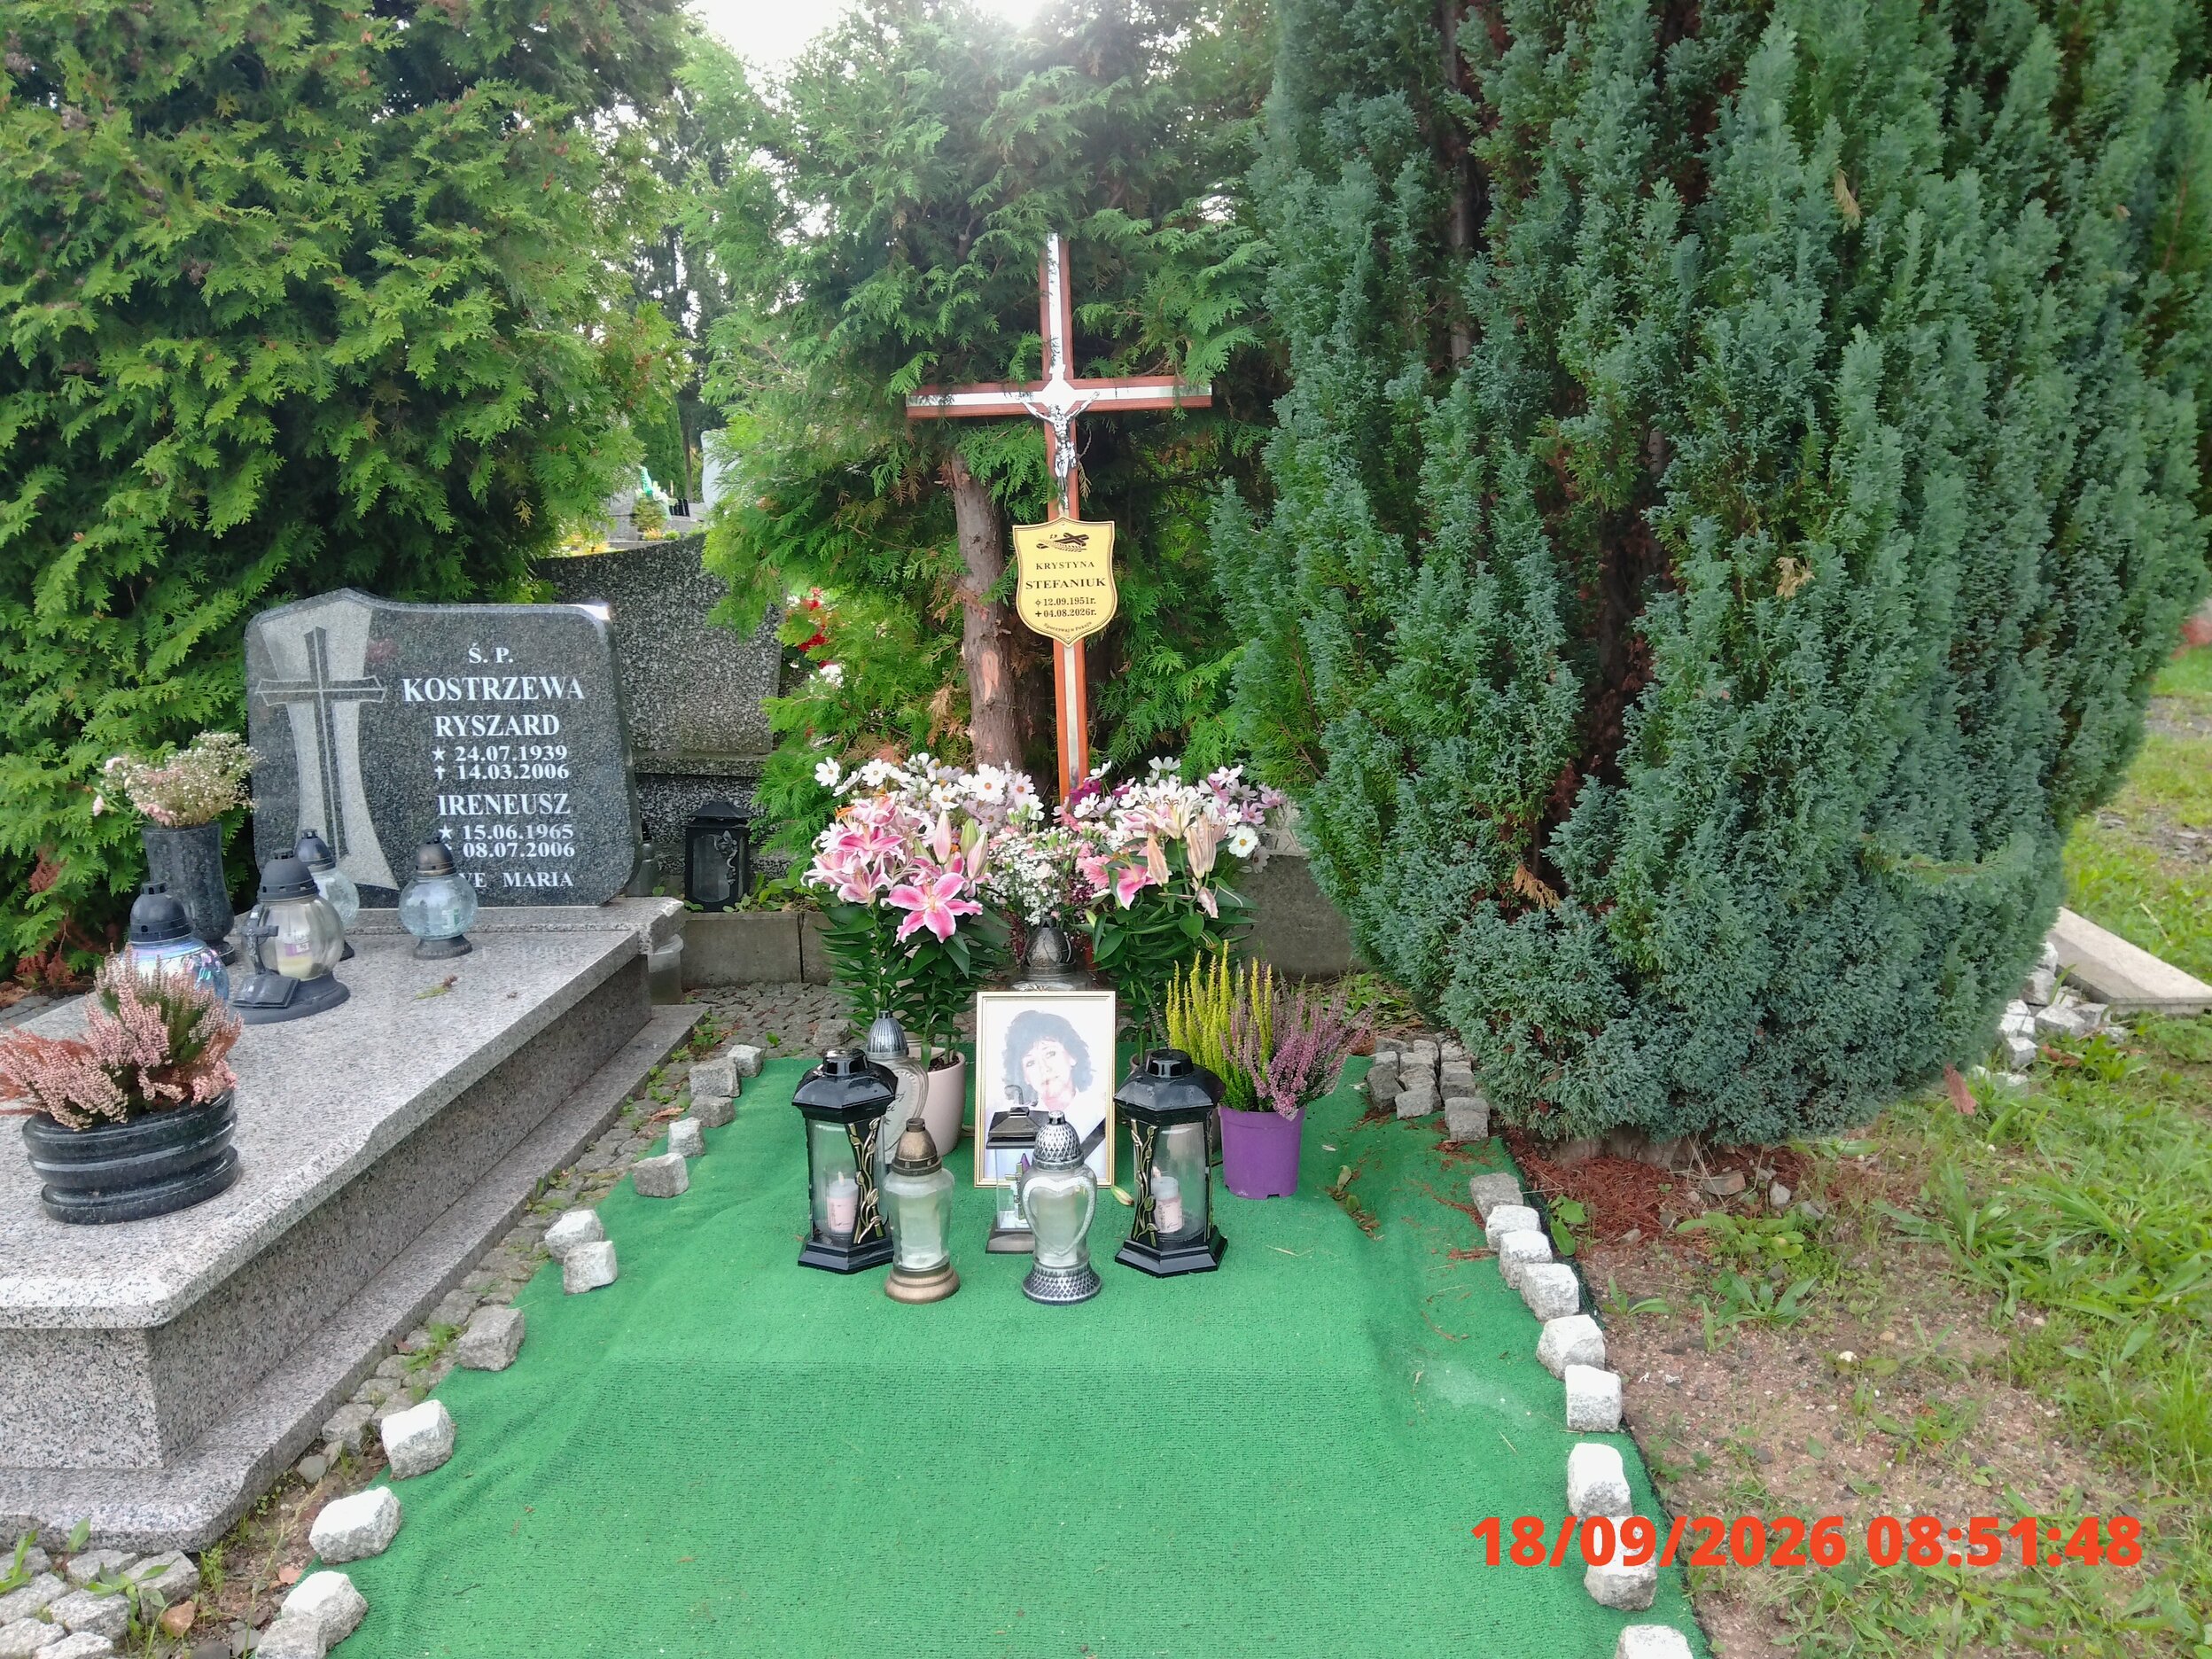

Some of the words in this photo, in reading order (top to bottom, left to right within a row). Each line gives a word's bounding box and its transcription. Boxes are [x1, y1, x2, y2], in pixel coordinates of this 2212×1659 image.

[1035, 560, 1095, 571] KRYSTYNA
[1025, 577, 1106, 590] STEFANIUK
[1043, 596, 1096, 607] 12.09.1951r.
[1043, 608, 1097, 619] 04.08.2026r.
[468, 643, 488, 664] Ś.
[495, 647, 514, 664] P.
[402, 676, 586, 702] KOSTRZEWA
[434, 714, 560, 737] RYSZARD
[455, 745, 568, 761] 24.07.1939
[457, 763, 570, 780] 14.03.2006
[438, 793, 571, 816] IRENEUSZ
[463, 824, 574, 840] 15.06.1965
[463, 842, 575, 858] 08.07.2006
[458, 872, 487, 888] VE
[502, 871, 574, 887] MARIA
